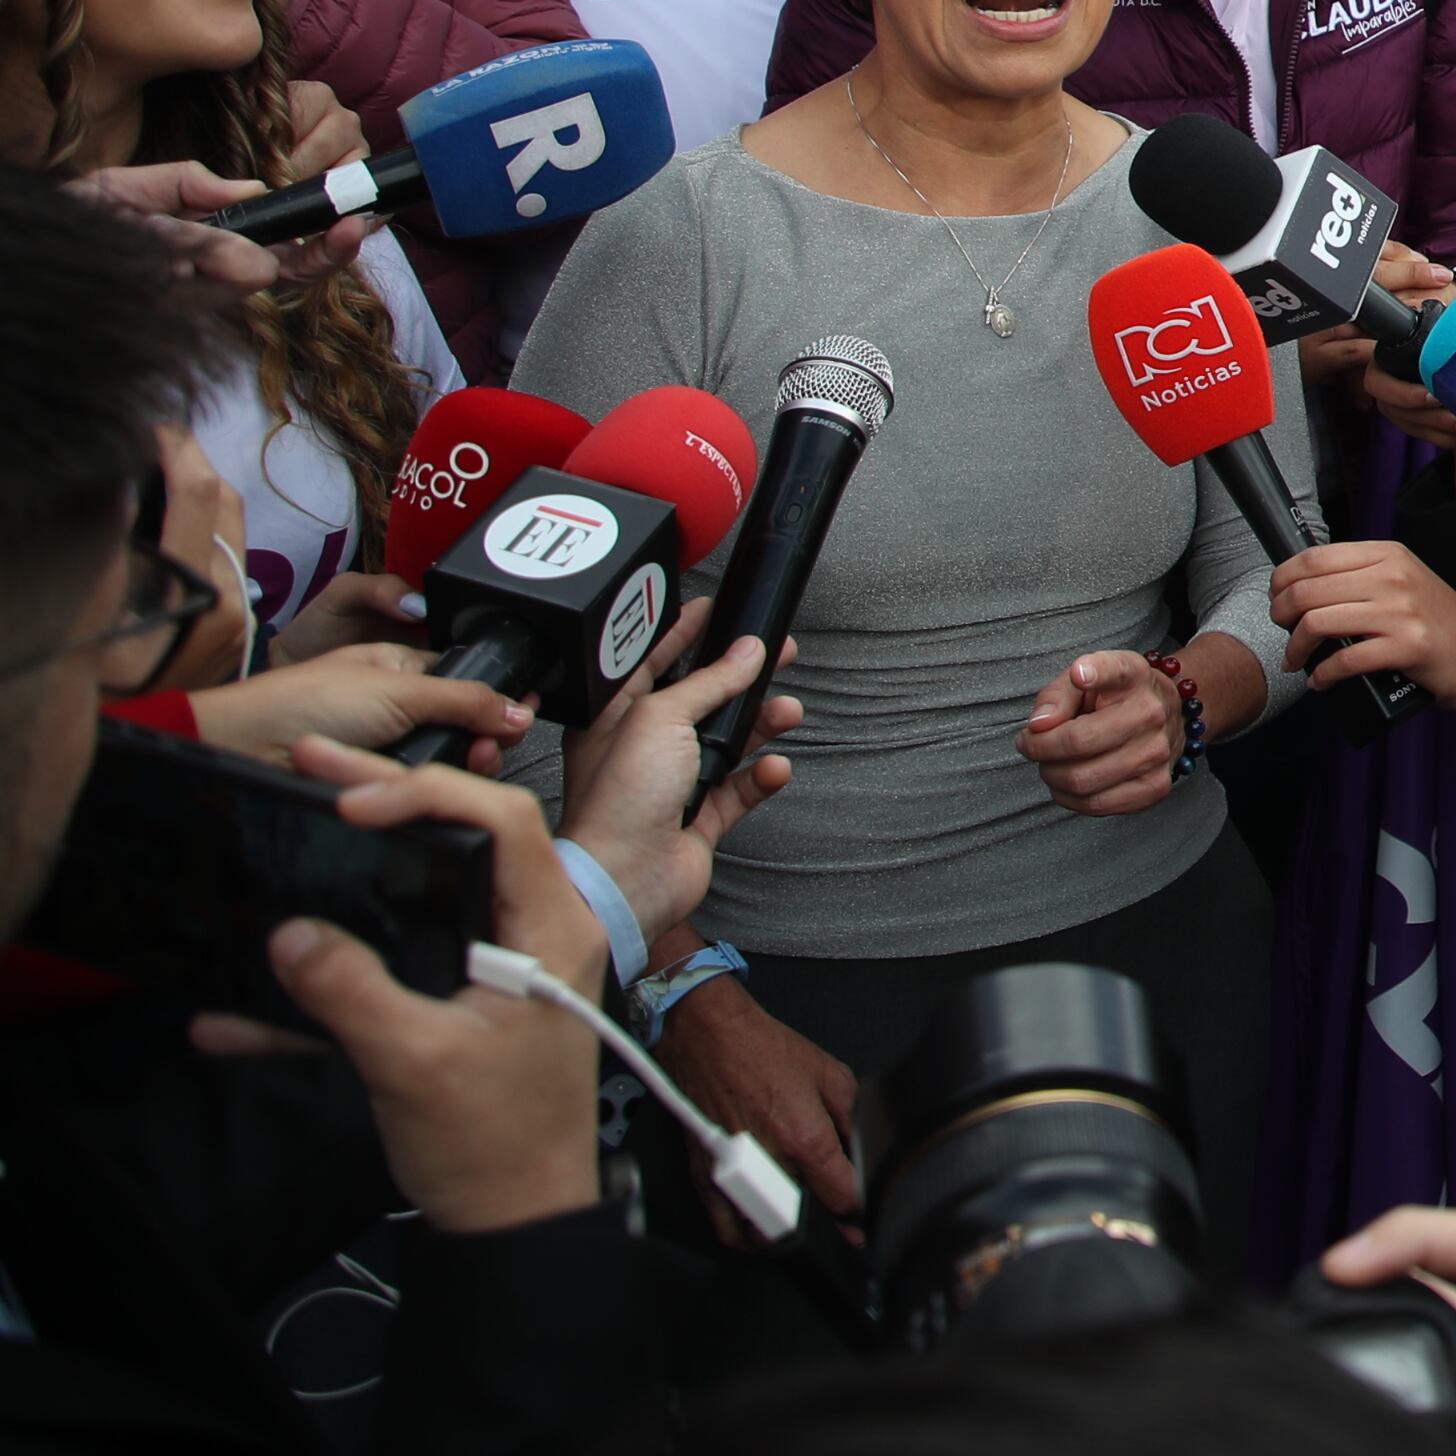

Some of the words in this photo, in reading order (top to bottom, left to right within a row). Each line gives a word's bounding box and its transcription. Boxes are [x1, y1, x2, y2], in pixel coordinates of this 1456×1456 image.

[1310, 171, 1364, 270] red
[1357, 202, 1380, 246] noticias
[1250, 278, 1303, 319] ed
[1140, 360, 1243, 412] Noticias
[800, 415, 852, 437] SAMSON
[398, 452, 468, 508] RACOL
[500, 515, 592, 569] EE
